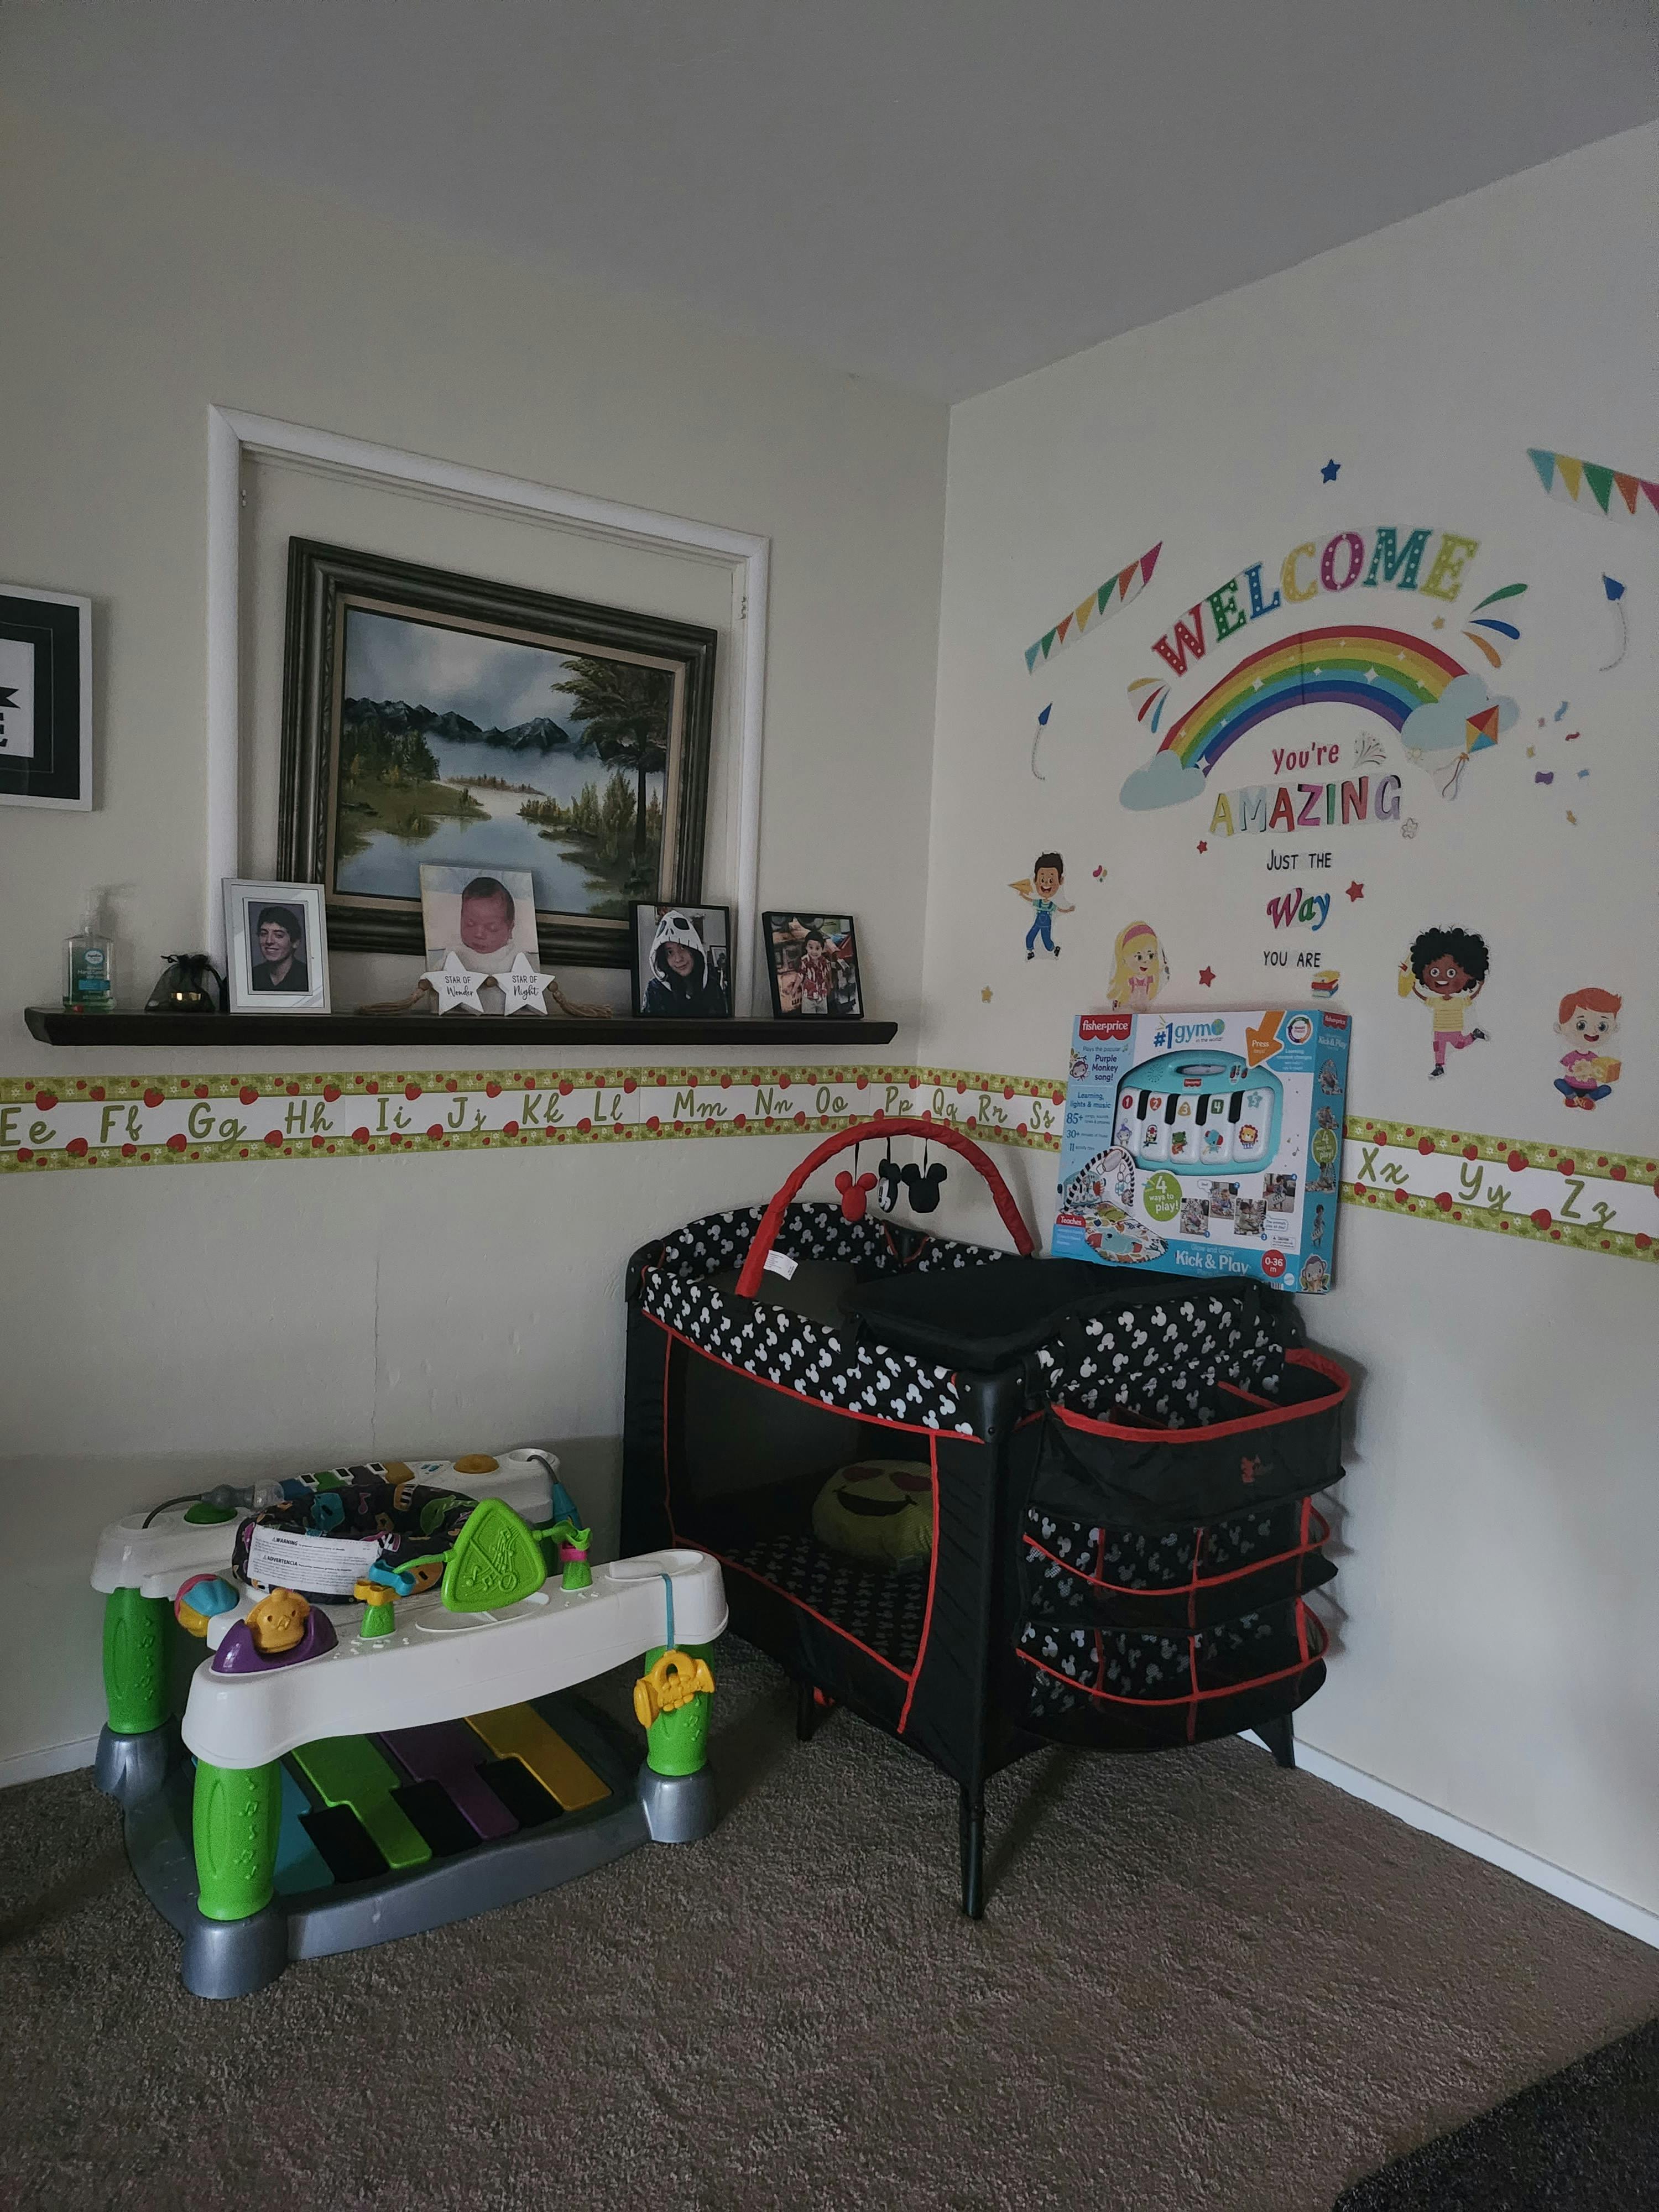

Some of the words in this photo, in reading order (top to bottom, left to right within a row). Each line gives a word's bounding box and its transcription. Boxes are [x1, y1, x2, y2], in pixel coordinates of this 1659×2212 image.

[1151, 526, 1480, 677] WELCOME
[1209, 775, 1401, 836] AMAZING
[1309, 852, 1332, 868] THE
[1266, 888, 1331, 931] Way
[1264, 951, 1287, 967] YOU
[1296, 952, 1321, 968] ARE
[447, 986, 473, 997] Wonder
[513, 985, 539, 1000] Night
[1252, 1040, 1269, 1048] Press
[1095, 1055, 1117, 1064] Purple
[1092, 1063, 1118, 1073] Monkey
[1094, 1073, 1113, 1082] song!
[1070, 1100, 1086, 1109] lights
[1214, 1101, 1221, 1112] 4
[1066, 1112, 1083, 1124] 85+
[1066, 1129, 1079, 1138] 30+
[1155, 1175, 1167, 1194] 4
[1155, 1201, 1179, 1214] play!
[1061, 1216, 1082, 1226] Teaches
[1175, 1249, 1203, 1267] Kick
[1204, 1254, 1217, 1269] &
[1219, 1255, 1249, 1275] Play
[1265, 1256, 1284, 1266] 0-36
[276, 1537, 298, 1546] WARNING
[267, 1556, 298, 1566] ADVERTENCIA
